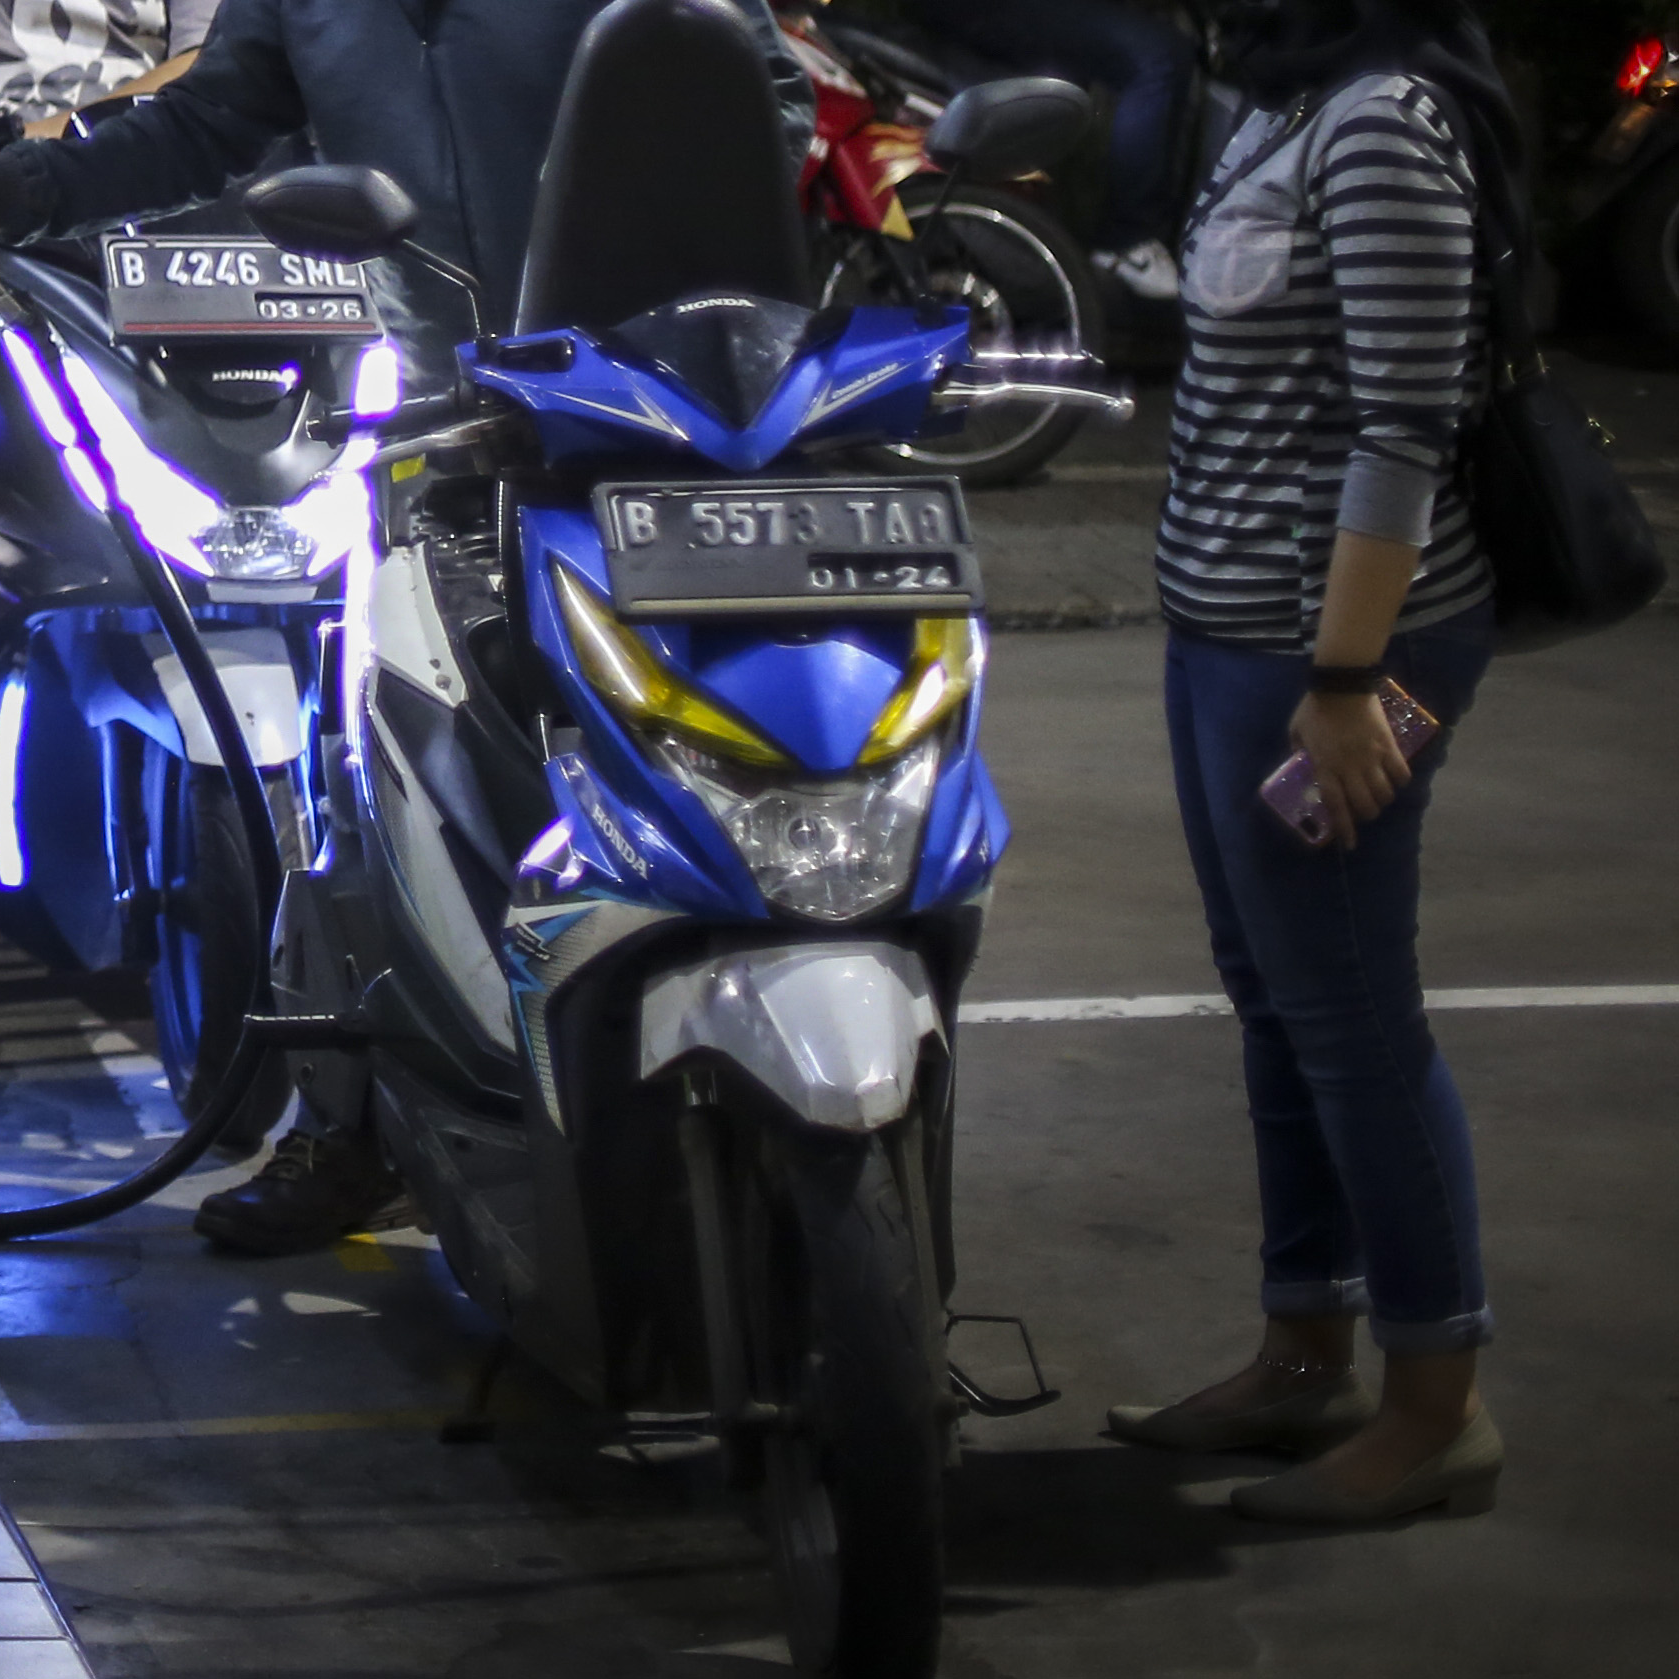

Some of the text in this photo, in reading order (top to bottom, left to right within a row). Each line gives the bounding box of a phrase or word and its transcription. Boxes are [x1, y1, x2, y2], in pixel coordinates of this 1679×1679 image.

[120, 251, 145, 287] B
[165, 250, 261, 287] 4246
[212, 369, 285, 382] HONDA
[624, 501, 657, 546] B
[591, 802, 649, 881] HONDA
